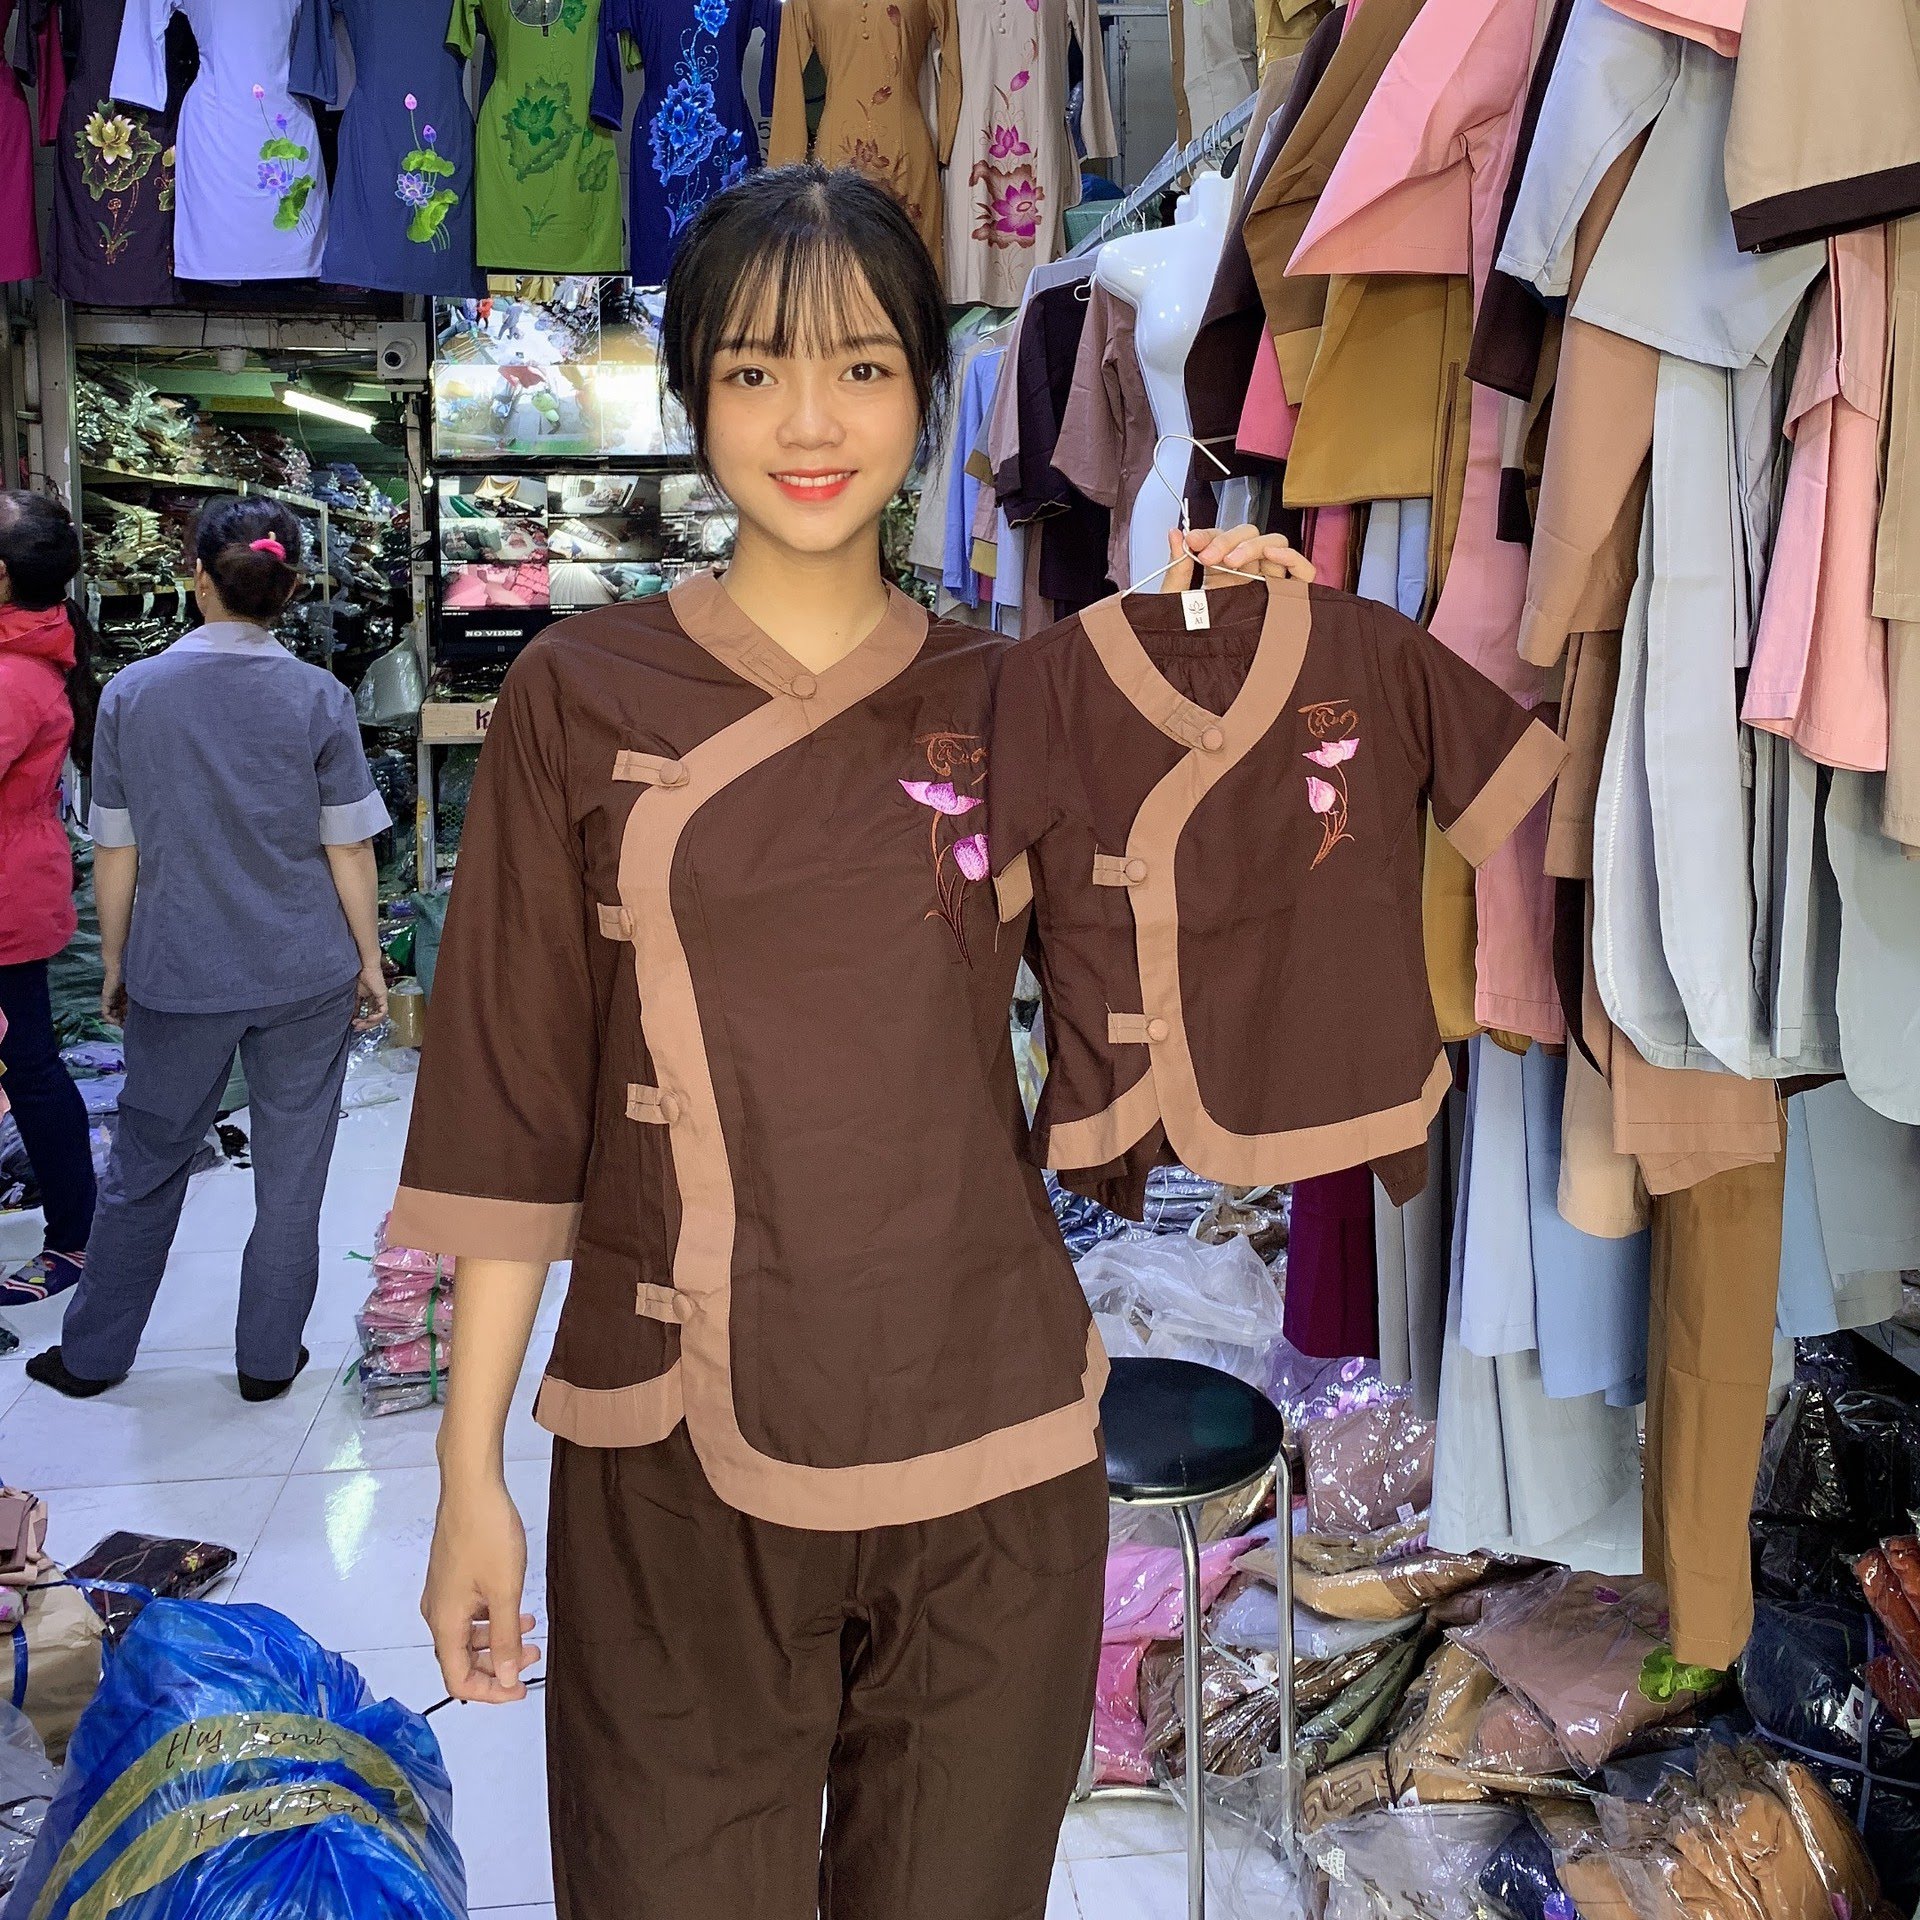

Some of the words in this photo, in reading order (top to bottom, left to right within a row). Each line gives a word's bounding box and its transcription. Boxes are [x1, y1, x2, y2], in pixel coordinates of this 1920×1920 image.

[485, 629, 523, 637] VIDEO
[165, 1723, 222, 1770] Huy
[194, 1797, 273, 1849] Huy
